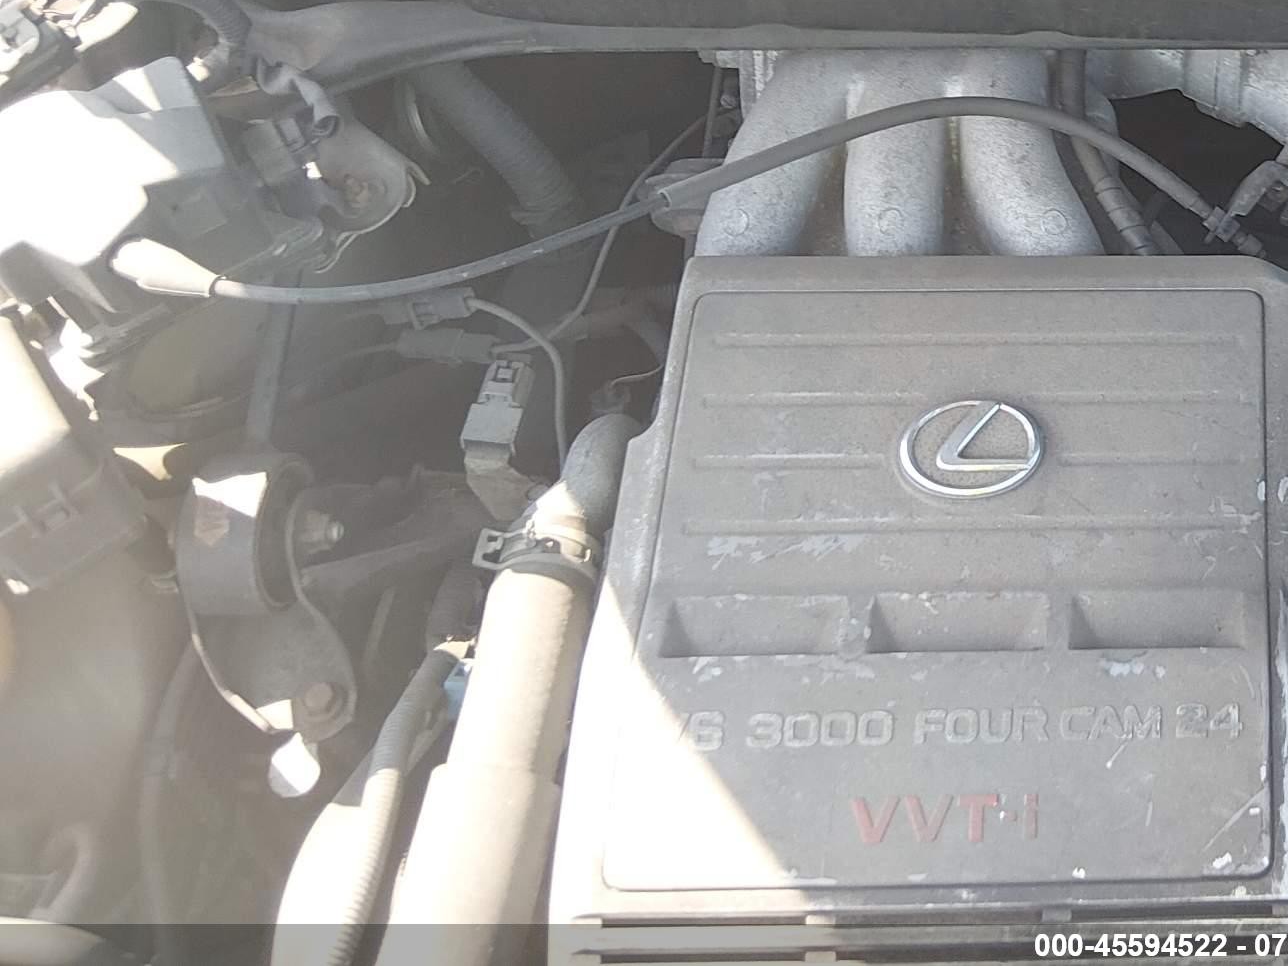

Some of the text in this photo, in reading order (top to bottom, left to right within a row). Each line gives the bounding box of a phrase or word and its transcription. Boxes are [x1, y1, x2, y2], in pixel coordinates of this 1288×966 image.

[745, 710, 894, 748] 3000
[913, 705, 1048, 745] FOUR
[1058, 704, 1162, 740] CAM
[1175, 701, 1243, 739] 24
